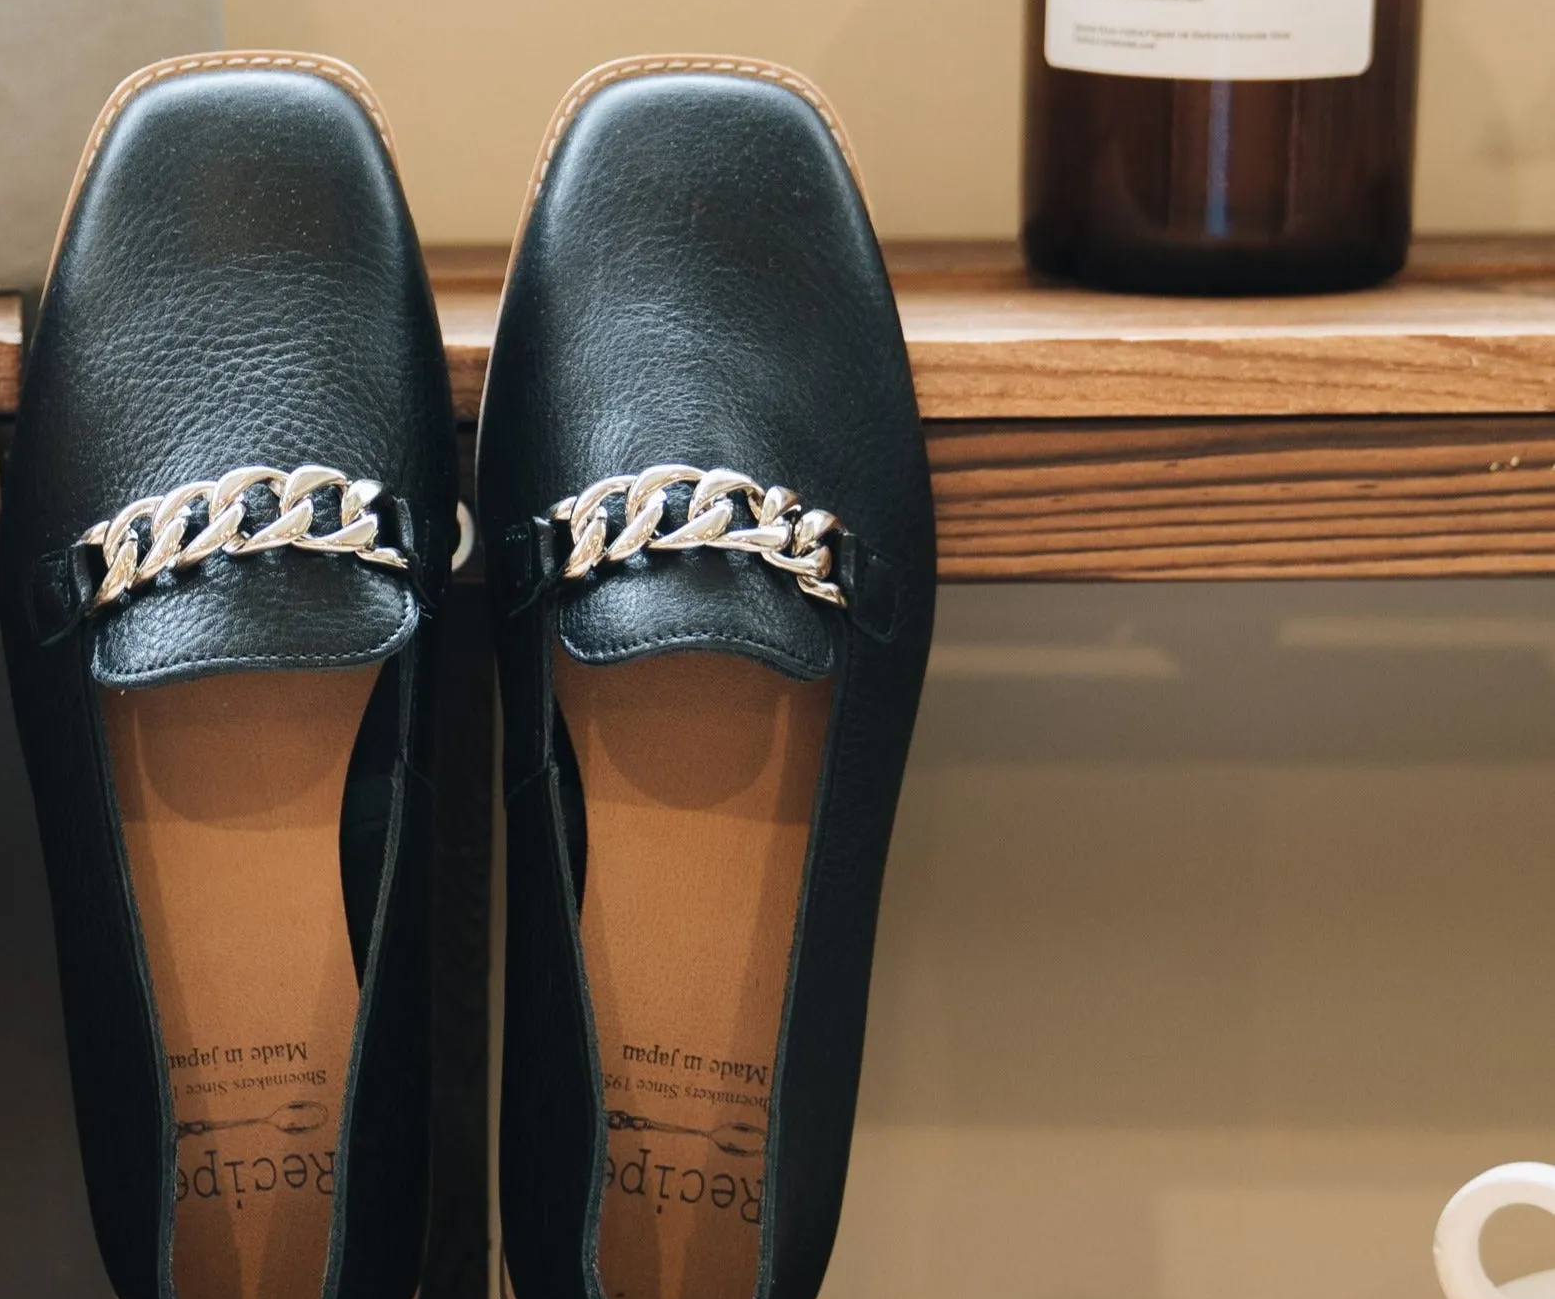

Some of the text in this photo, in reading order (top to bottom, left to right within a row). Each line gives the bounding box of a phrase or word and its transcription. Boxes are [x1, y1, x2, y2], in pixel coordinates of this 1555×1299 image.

[225, 1049, 242, 1065] in
[251, 1042, 307, 1062] Made
[684, 1055, 702, 1075] in
[710, 1060, 768, 1085] Made
[185, 1079, 227, 1095] Since
[233, 1070, 326, 1090] Shoemakers
[604, 1074, 768, 1112] hoemakers Since 195
